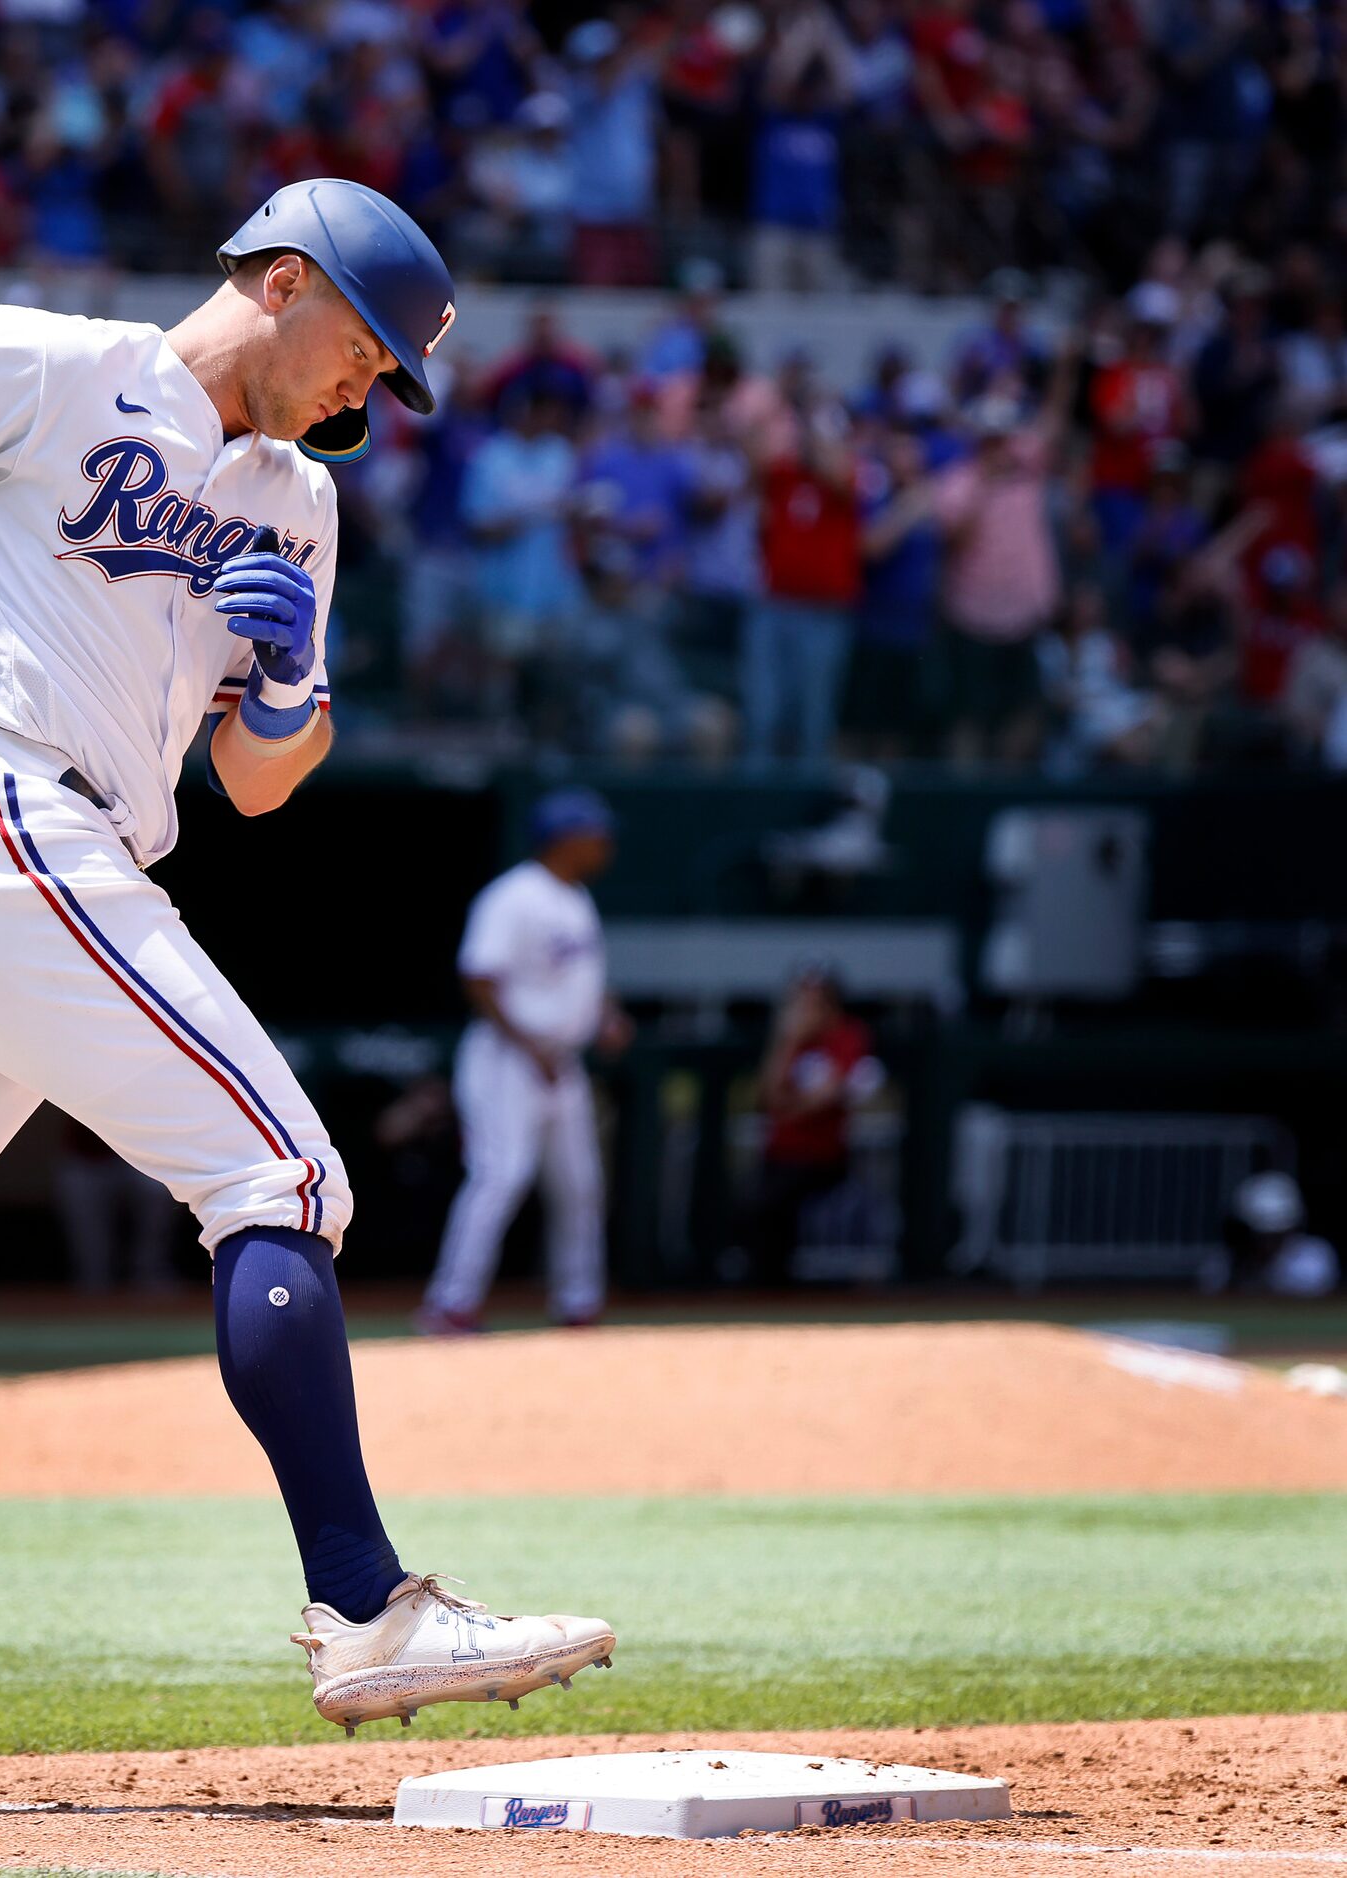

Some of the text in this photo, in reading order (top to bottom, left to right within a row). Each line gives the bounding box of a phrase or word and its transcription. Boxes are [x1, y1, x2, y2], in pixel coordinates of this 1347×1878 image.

[53, 435, 319, 598] Rangrs
[501, 1798, 569, 1828] Rangers
[821, 1799, 893, 1828] Rangers
